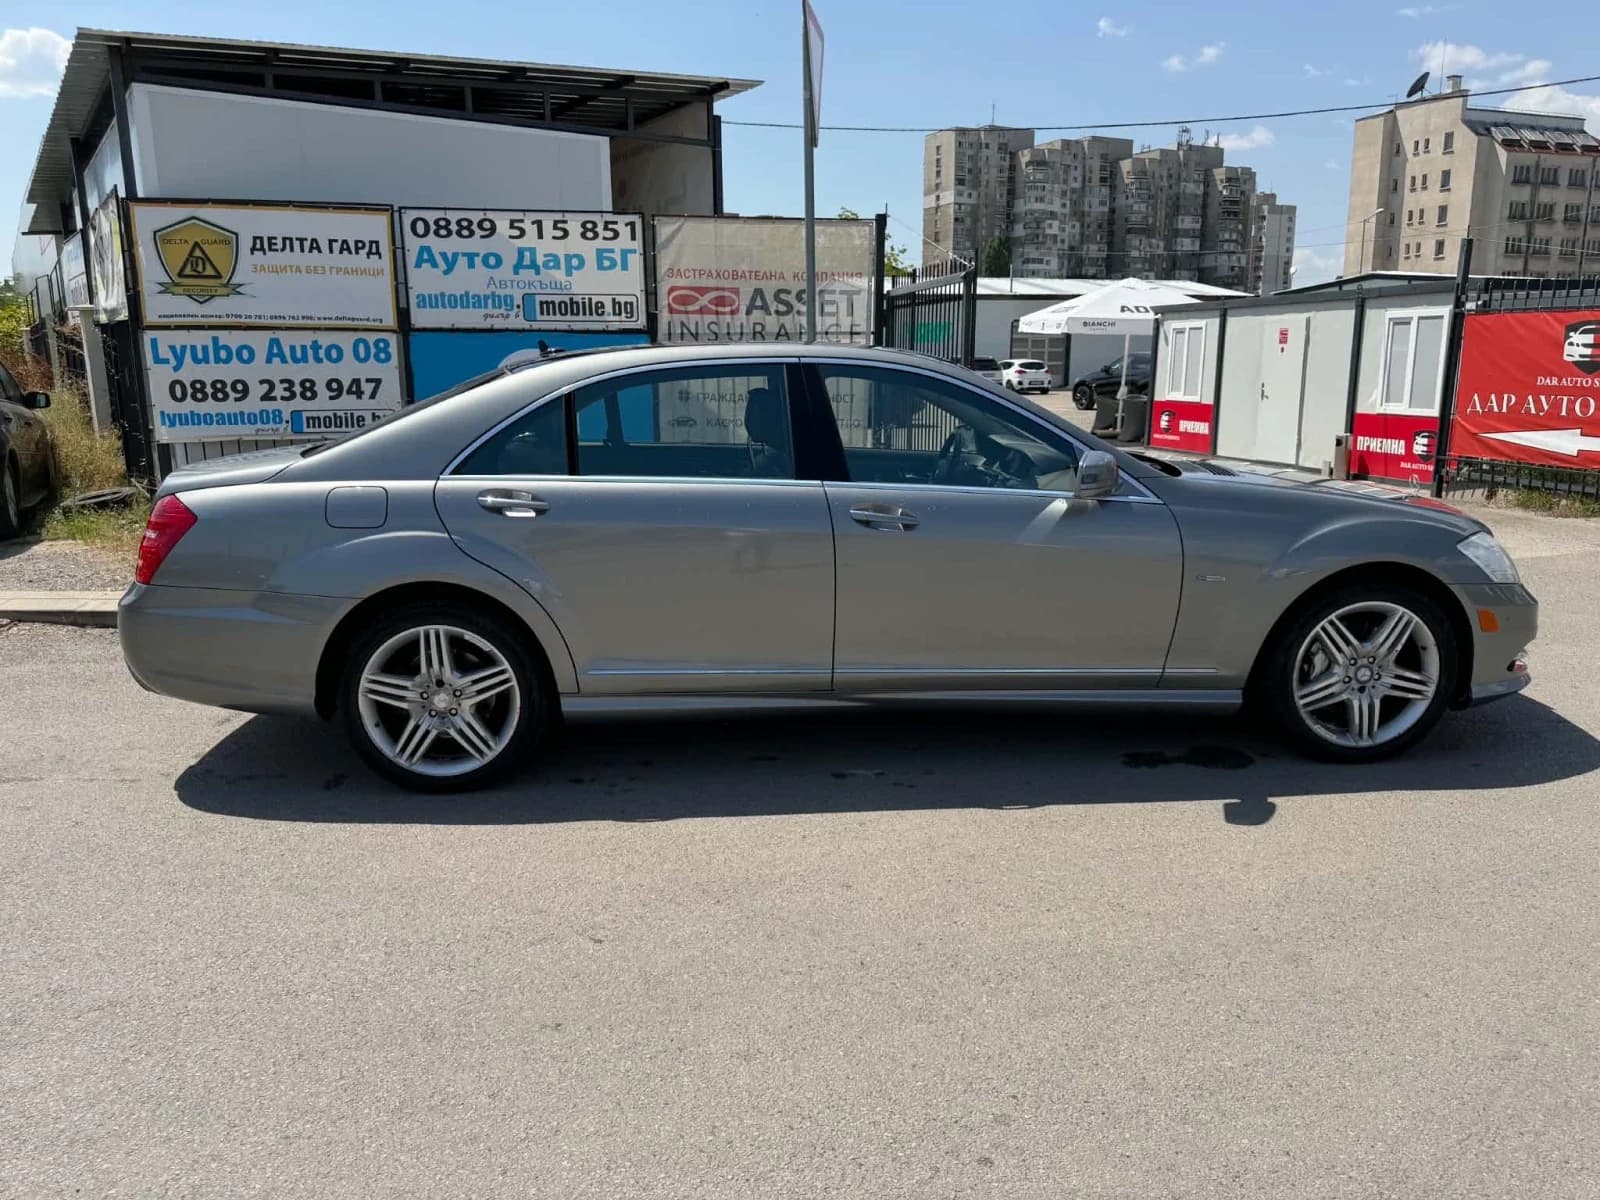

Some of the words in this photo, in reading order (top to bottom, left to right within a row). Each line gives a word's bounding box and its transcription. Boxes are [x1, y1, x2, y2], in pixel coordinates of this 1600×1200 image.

[410, 217, 497, 239] 0889
[508, 219, 569, 240] 515
[580, 220, 637, 241] 851
[250, 235, 323, 256] ДЕЛТА
[327, 238, 382, 260] ГАРД
[250, 264, 303, 275] ЗАЩИТА
[304, 265, 327, 275] БЕЗ
[329, 266, 385, 278] ГРАНИЦИ
[413, 245, 503, 276] Ауто
[512, 246, 586, 277] Дар
[595, 248, 637, 271] БГ
[486, 276, 572, 291] Автокъща
[667, 268, 785, 281] ЗАСТРАХОВАТЕЛНА
[793, 272, 863, 282] КОПАНИЯ
[150, 336, 255, 373] Lyubo
[265, 338, 344, 364] Auto
[352, 337, 392, 364] 08
[168, 379, 250, 403] 0889
[258, 378, 318, 402] 238
[325, 377, 383, 400] 947
[1536, 376, 1558, 386] DAR
[1560, 377, 1591, 387] AUTO
[1466, 393, 1516, 415] ДАР
[1521, 394, 1596, 418] АУТО
[1357, 436, 1405, 455] ПРИЕМНА
